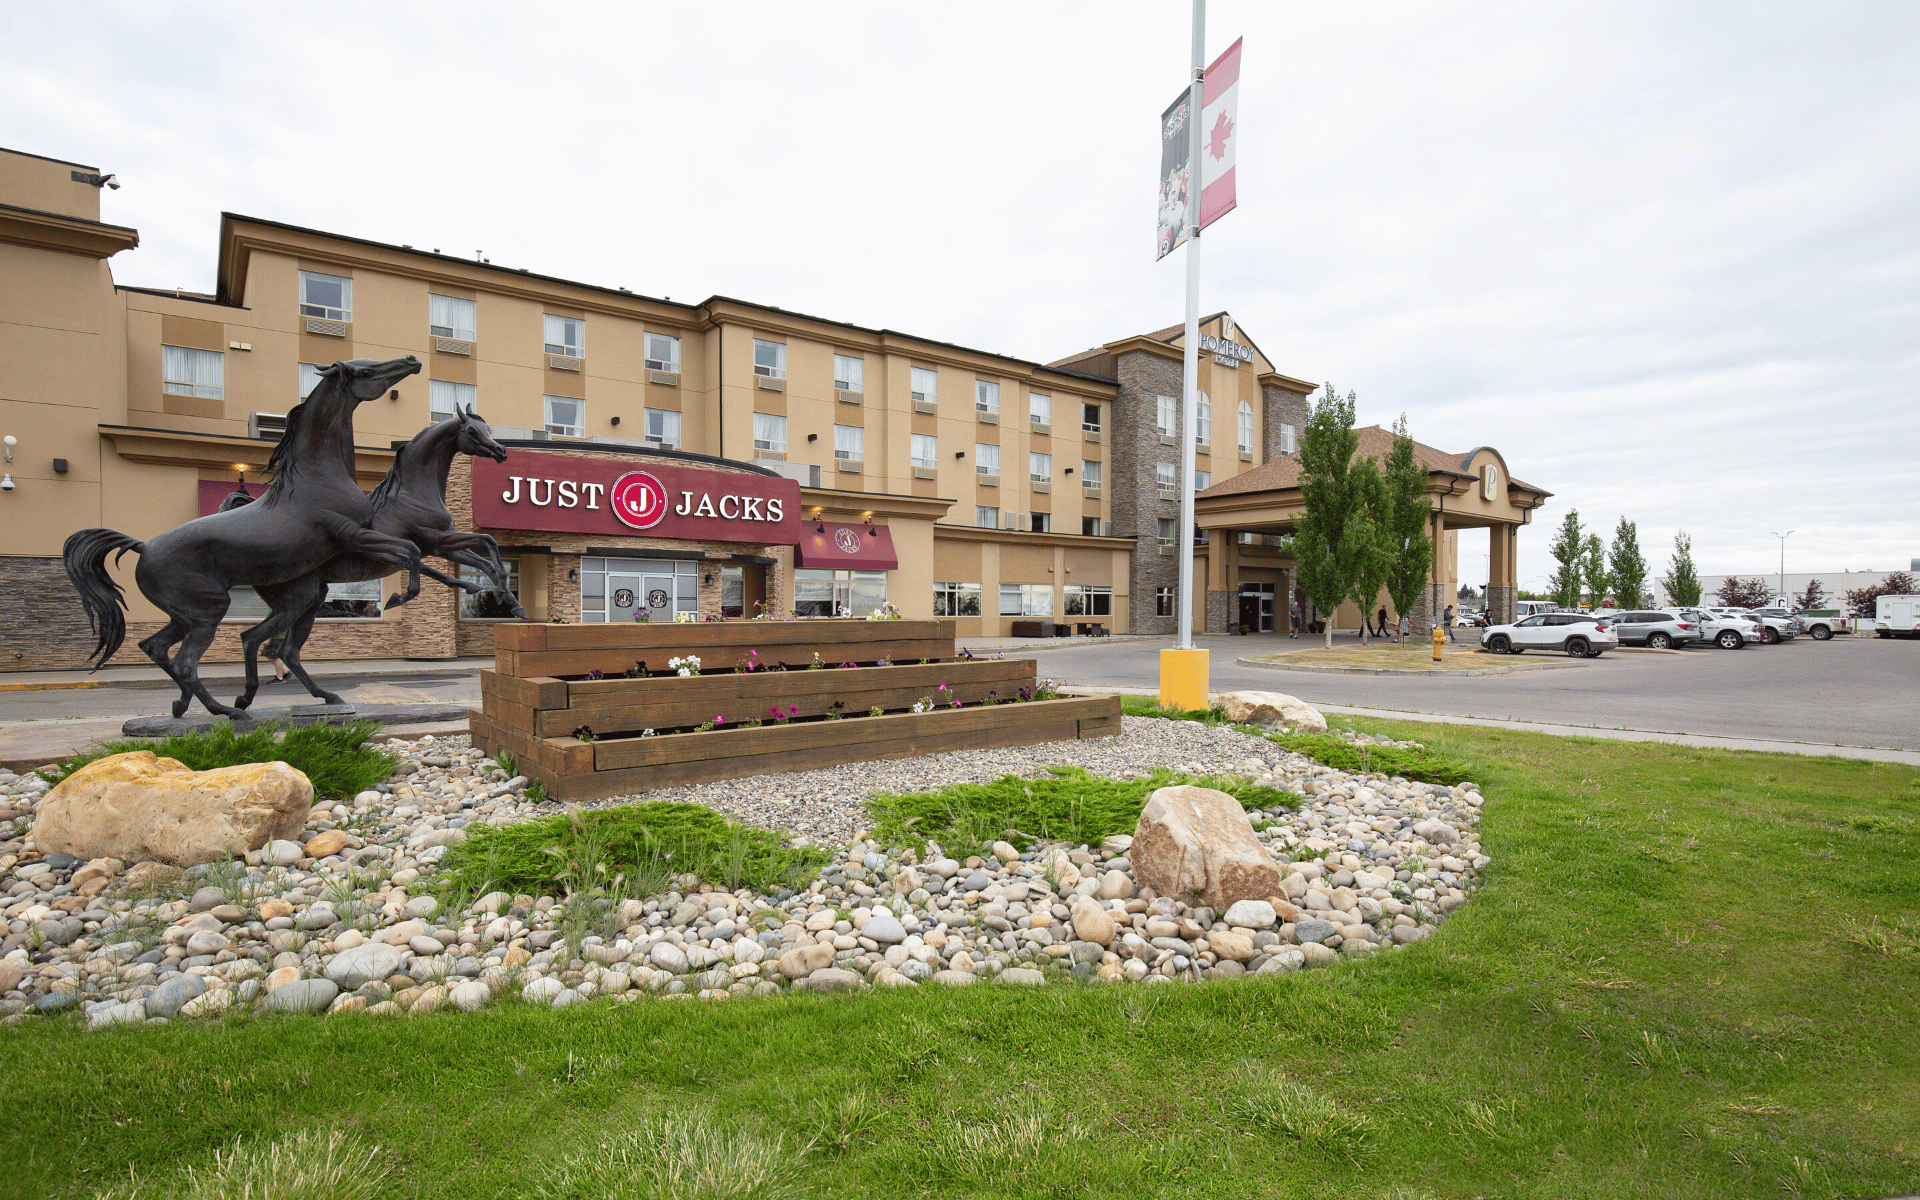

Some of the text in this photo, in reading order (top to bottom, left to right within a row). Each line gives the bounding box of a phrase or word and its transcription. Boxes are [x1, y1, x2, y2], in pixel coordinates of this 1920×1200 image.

[1199, 332, 1256, 363] POMEROY
[502, 475, 785, 522] JUST J JACKS
